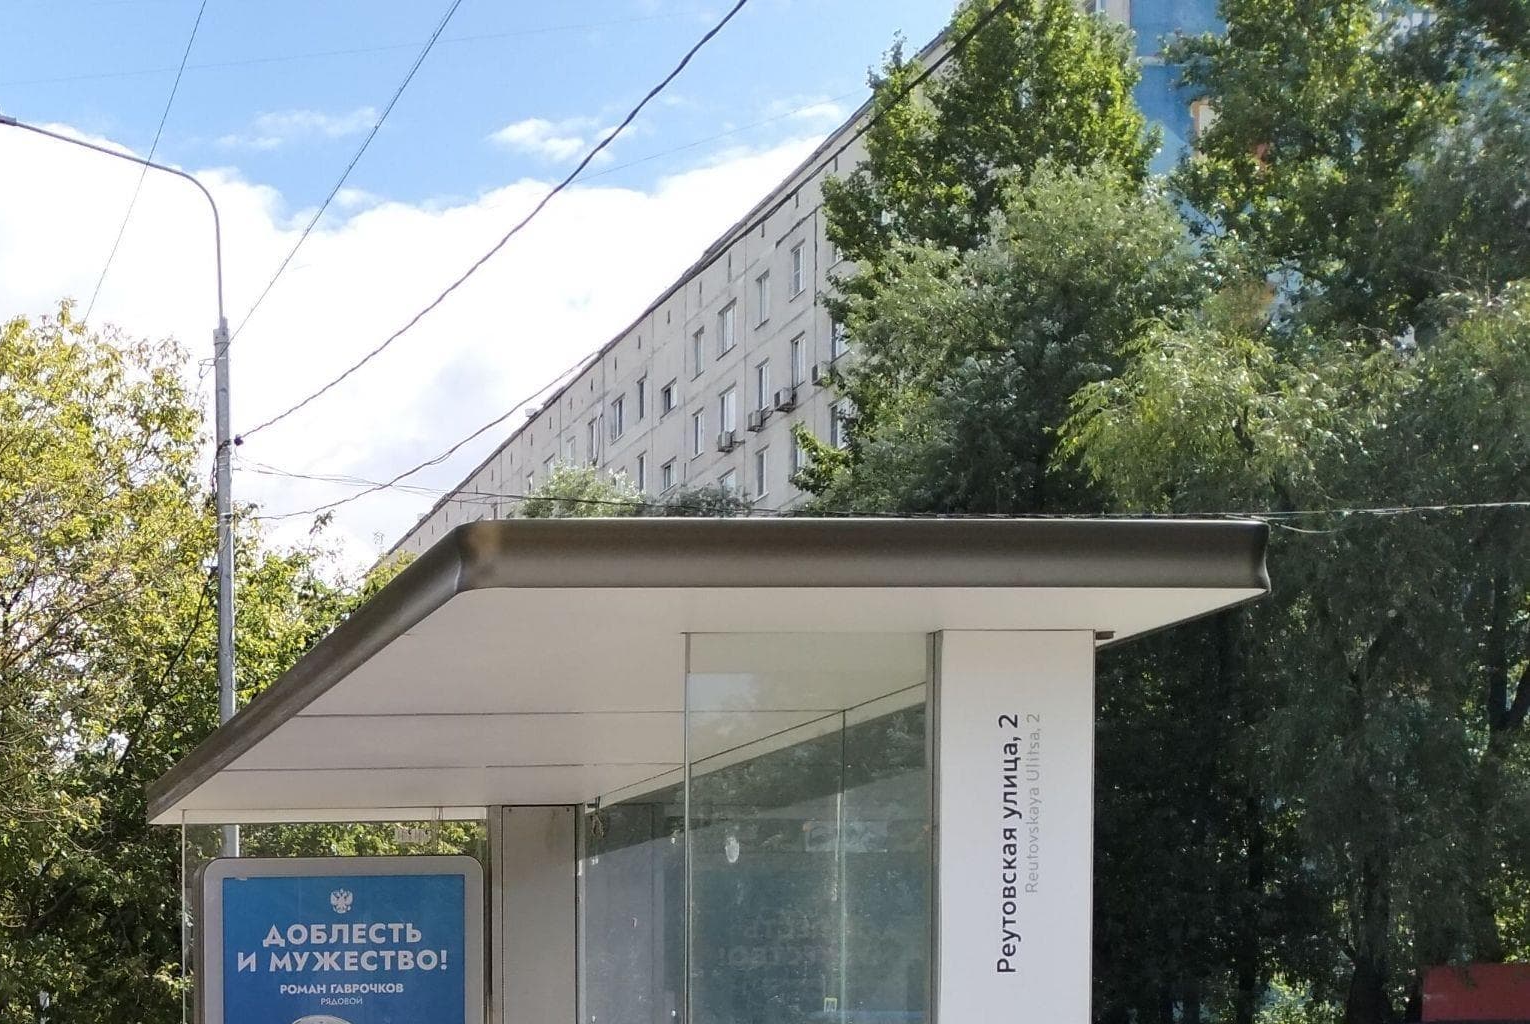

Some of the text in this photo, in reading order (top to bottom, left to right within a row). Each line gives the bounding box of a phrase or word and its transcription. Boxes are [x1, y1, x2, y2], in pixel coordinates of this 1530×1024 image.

[1025, 712, 1043, 894] Reutovskaya Ulitsa, 2
[996, 713, 1023, 974] Реутовская улица, 2
[262, 922, 422, 948] ДОБЛЕСТЬ
[236, 949, 448, 973] И МУЖЕСТВО!
[279, 982, 405, 995] РОМАН ГАВРОЧКОВ
[320, 997, 363, 1006] РЯДОВОЙ
